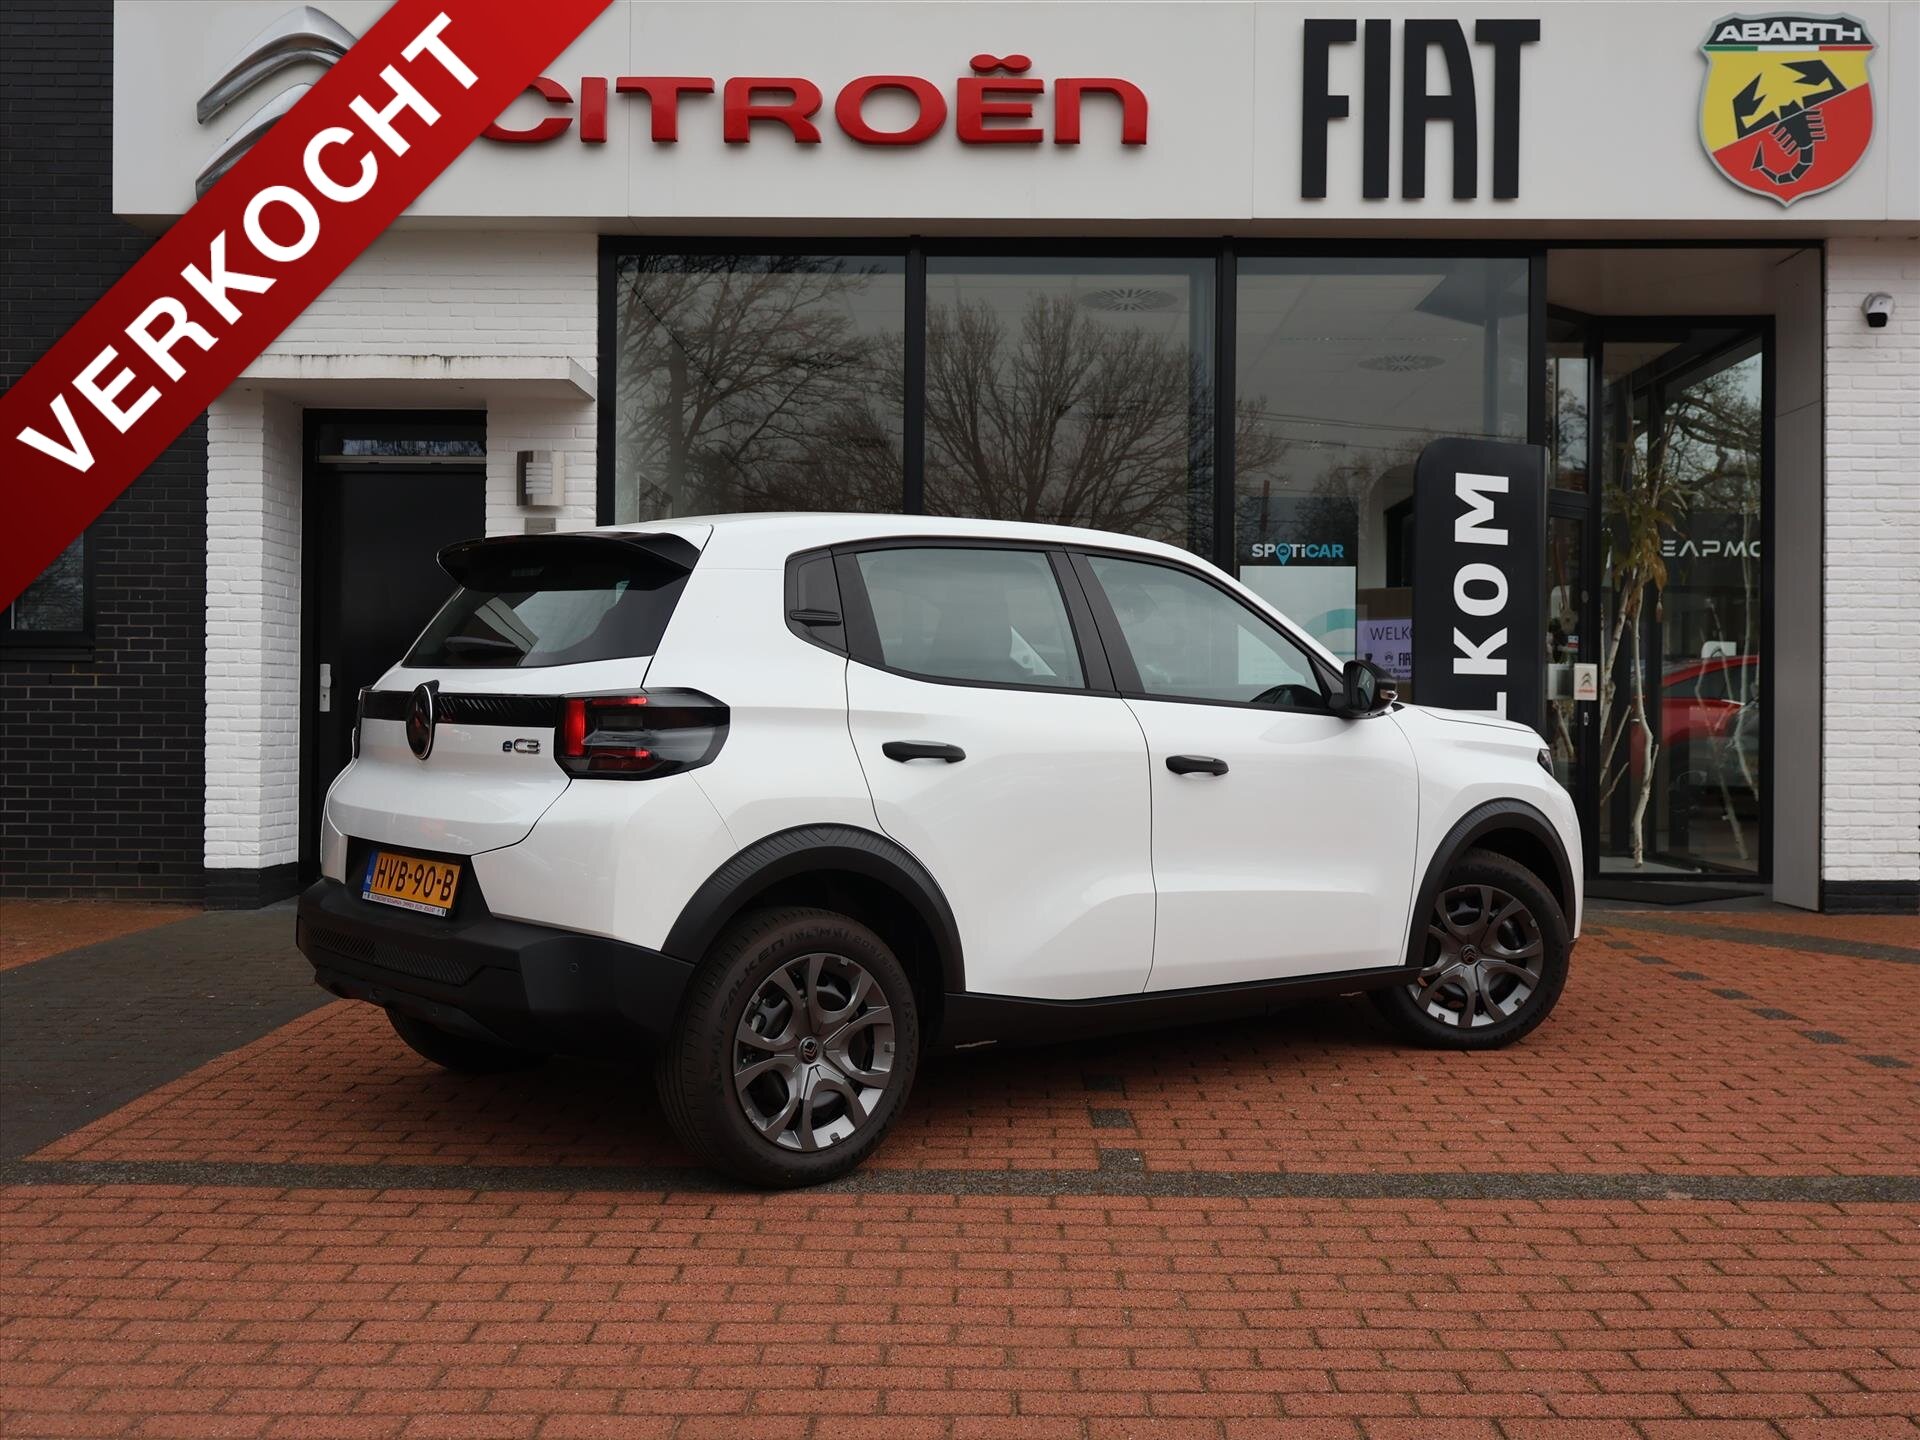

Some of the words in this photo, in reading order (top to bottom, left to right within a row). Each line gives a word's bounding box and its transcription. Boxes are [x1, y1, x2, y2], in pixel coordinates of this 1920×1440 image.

[1715, 21, 1861, 42] ABARTH
[480, 54, 1149, 145] CITROËN
[1301, 19, 1540, 199] FIAT
[1370, 626, 1412, 640] WELK
[374, 857, 455, 902] HVB-90-B
